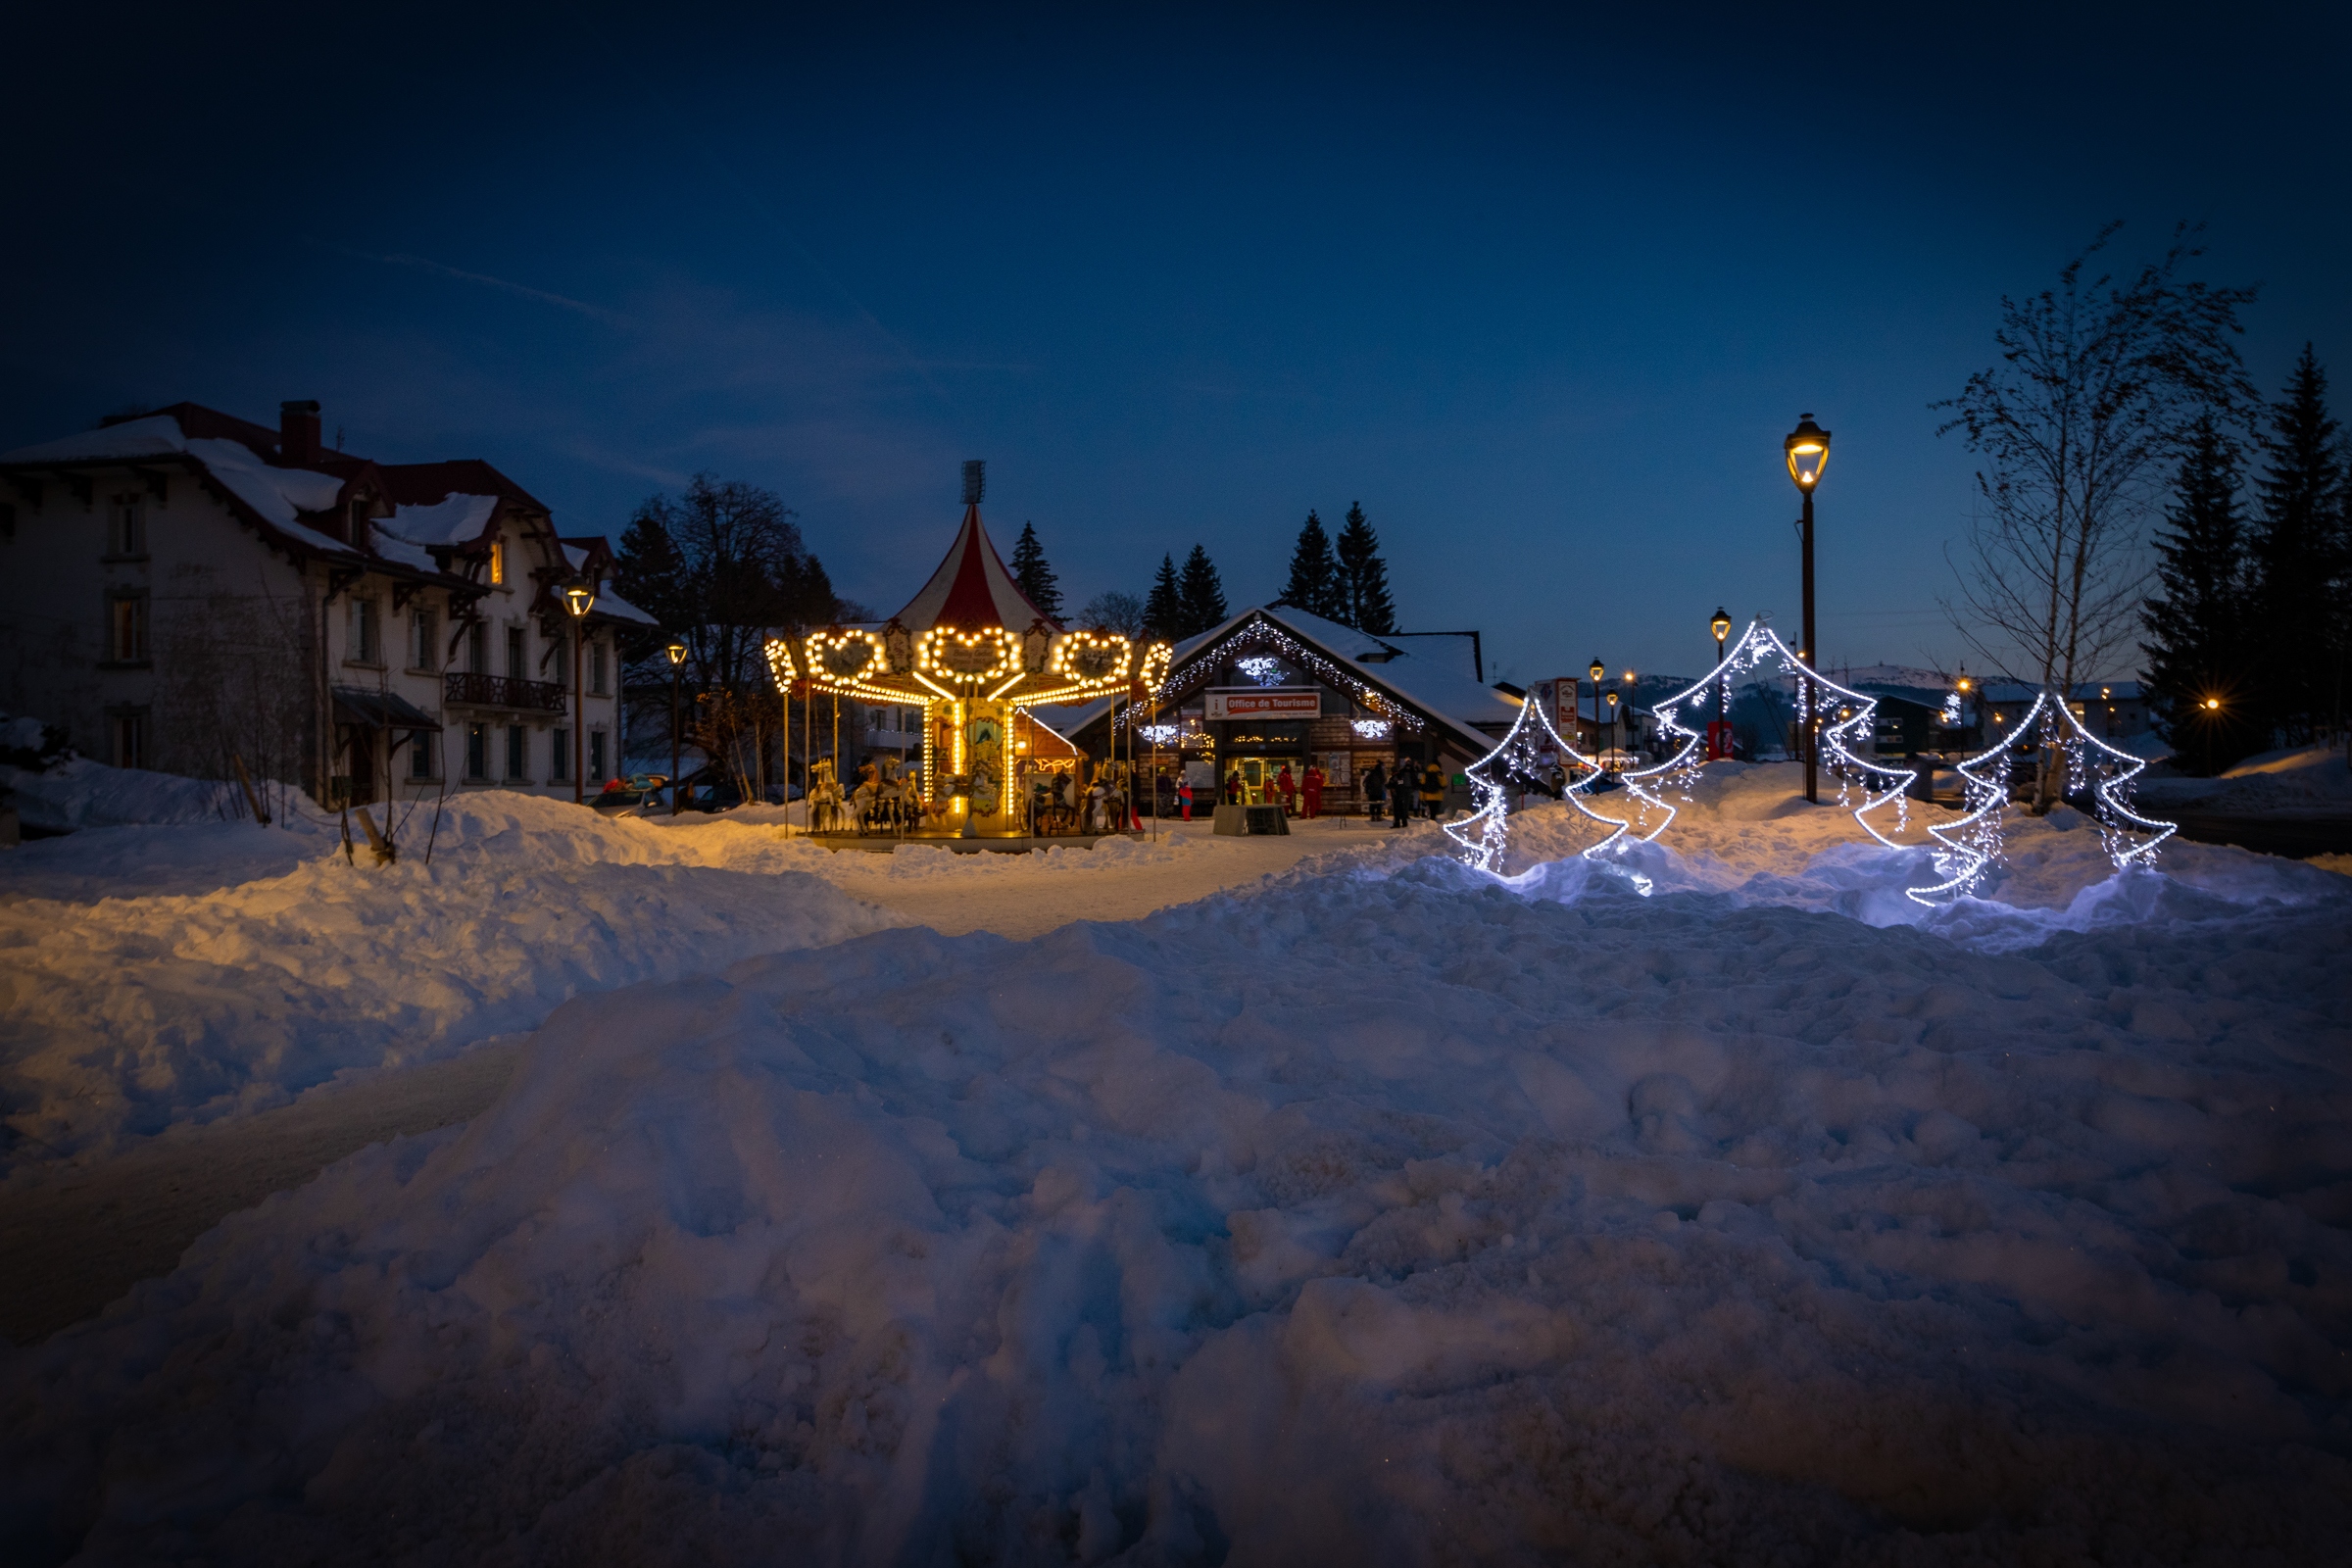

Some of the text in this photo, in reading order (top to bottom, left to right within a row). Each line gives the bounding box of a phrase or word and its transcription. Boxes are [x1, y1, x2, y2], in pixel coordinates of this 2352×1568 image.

[1228, 699, 1315, 708] Office de Tourisme
